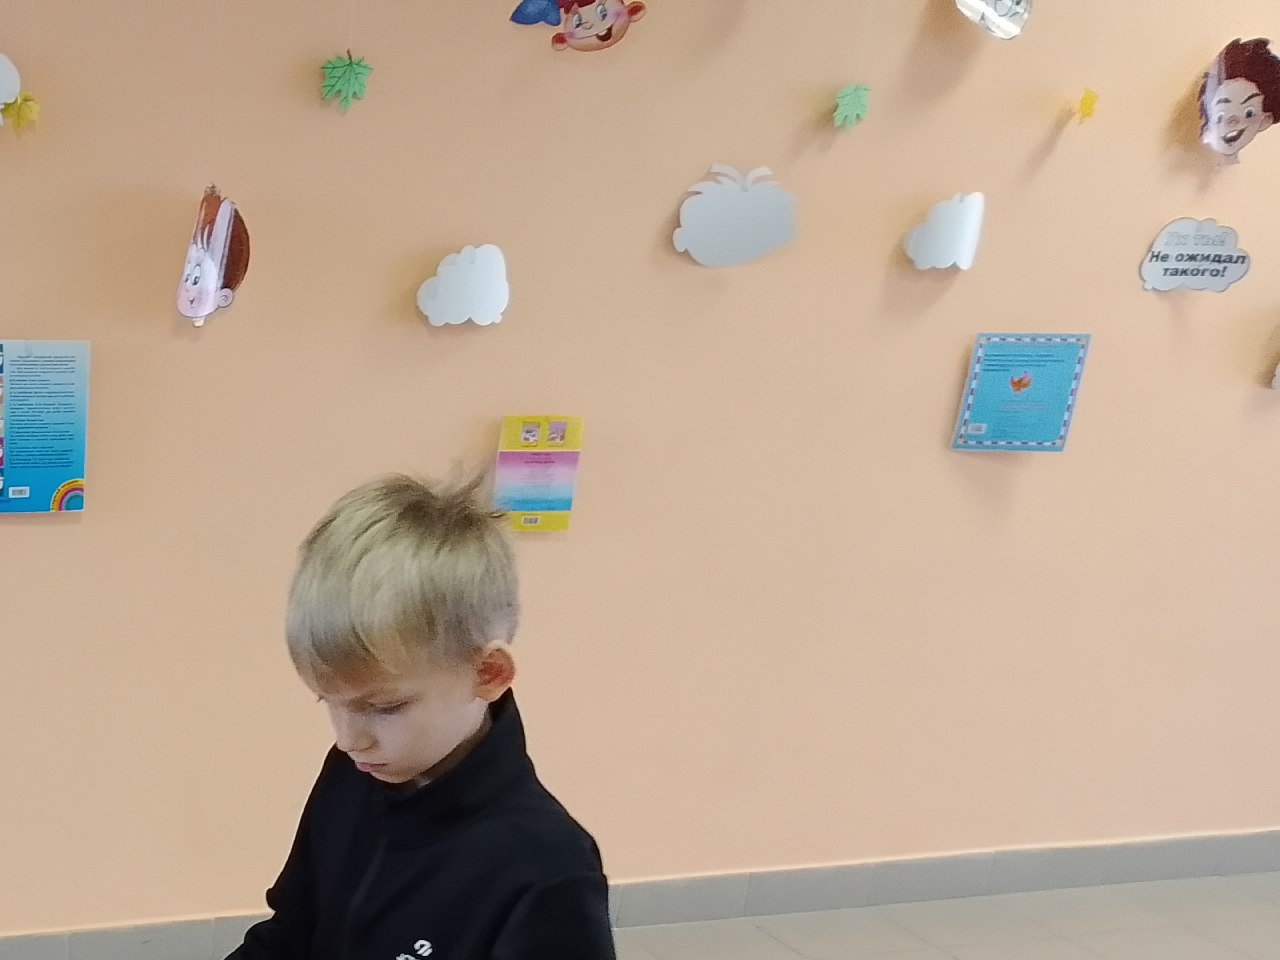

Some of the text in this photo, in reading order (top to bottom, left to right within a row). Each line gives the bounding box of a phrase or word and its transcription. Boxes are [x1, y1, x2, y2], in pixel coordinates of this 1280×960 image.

[1148, 250, 1247, 265] Не ожидал
[1161, 265, 1228, 278] такого!
